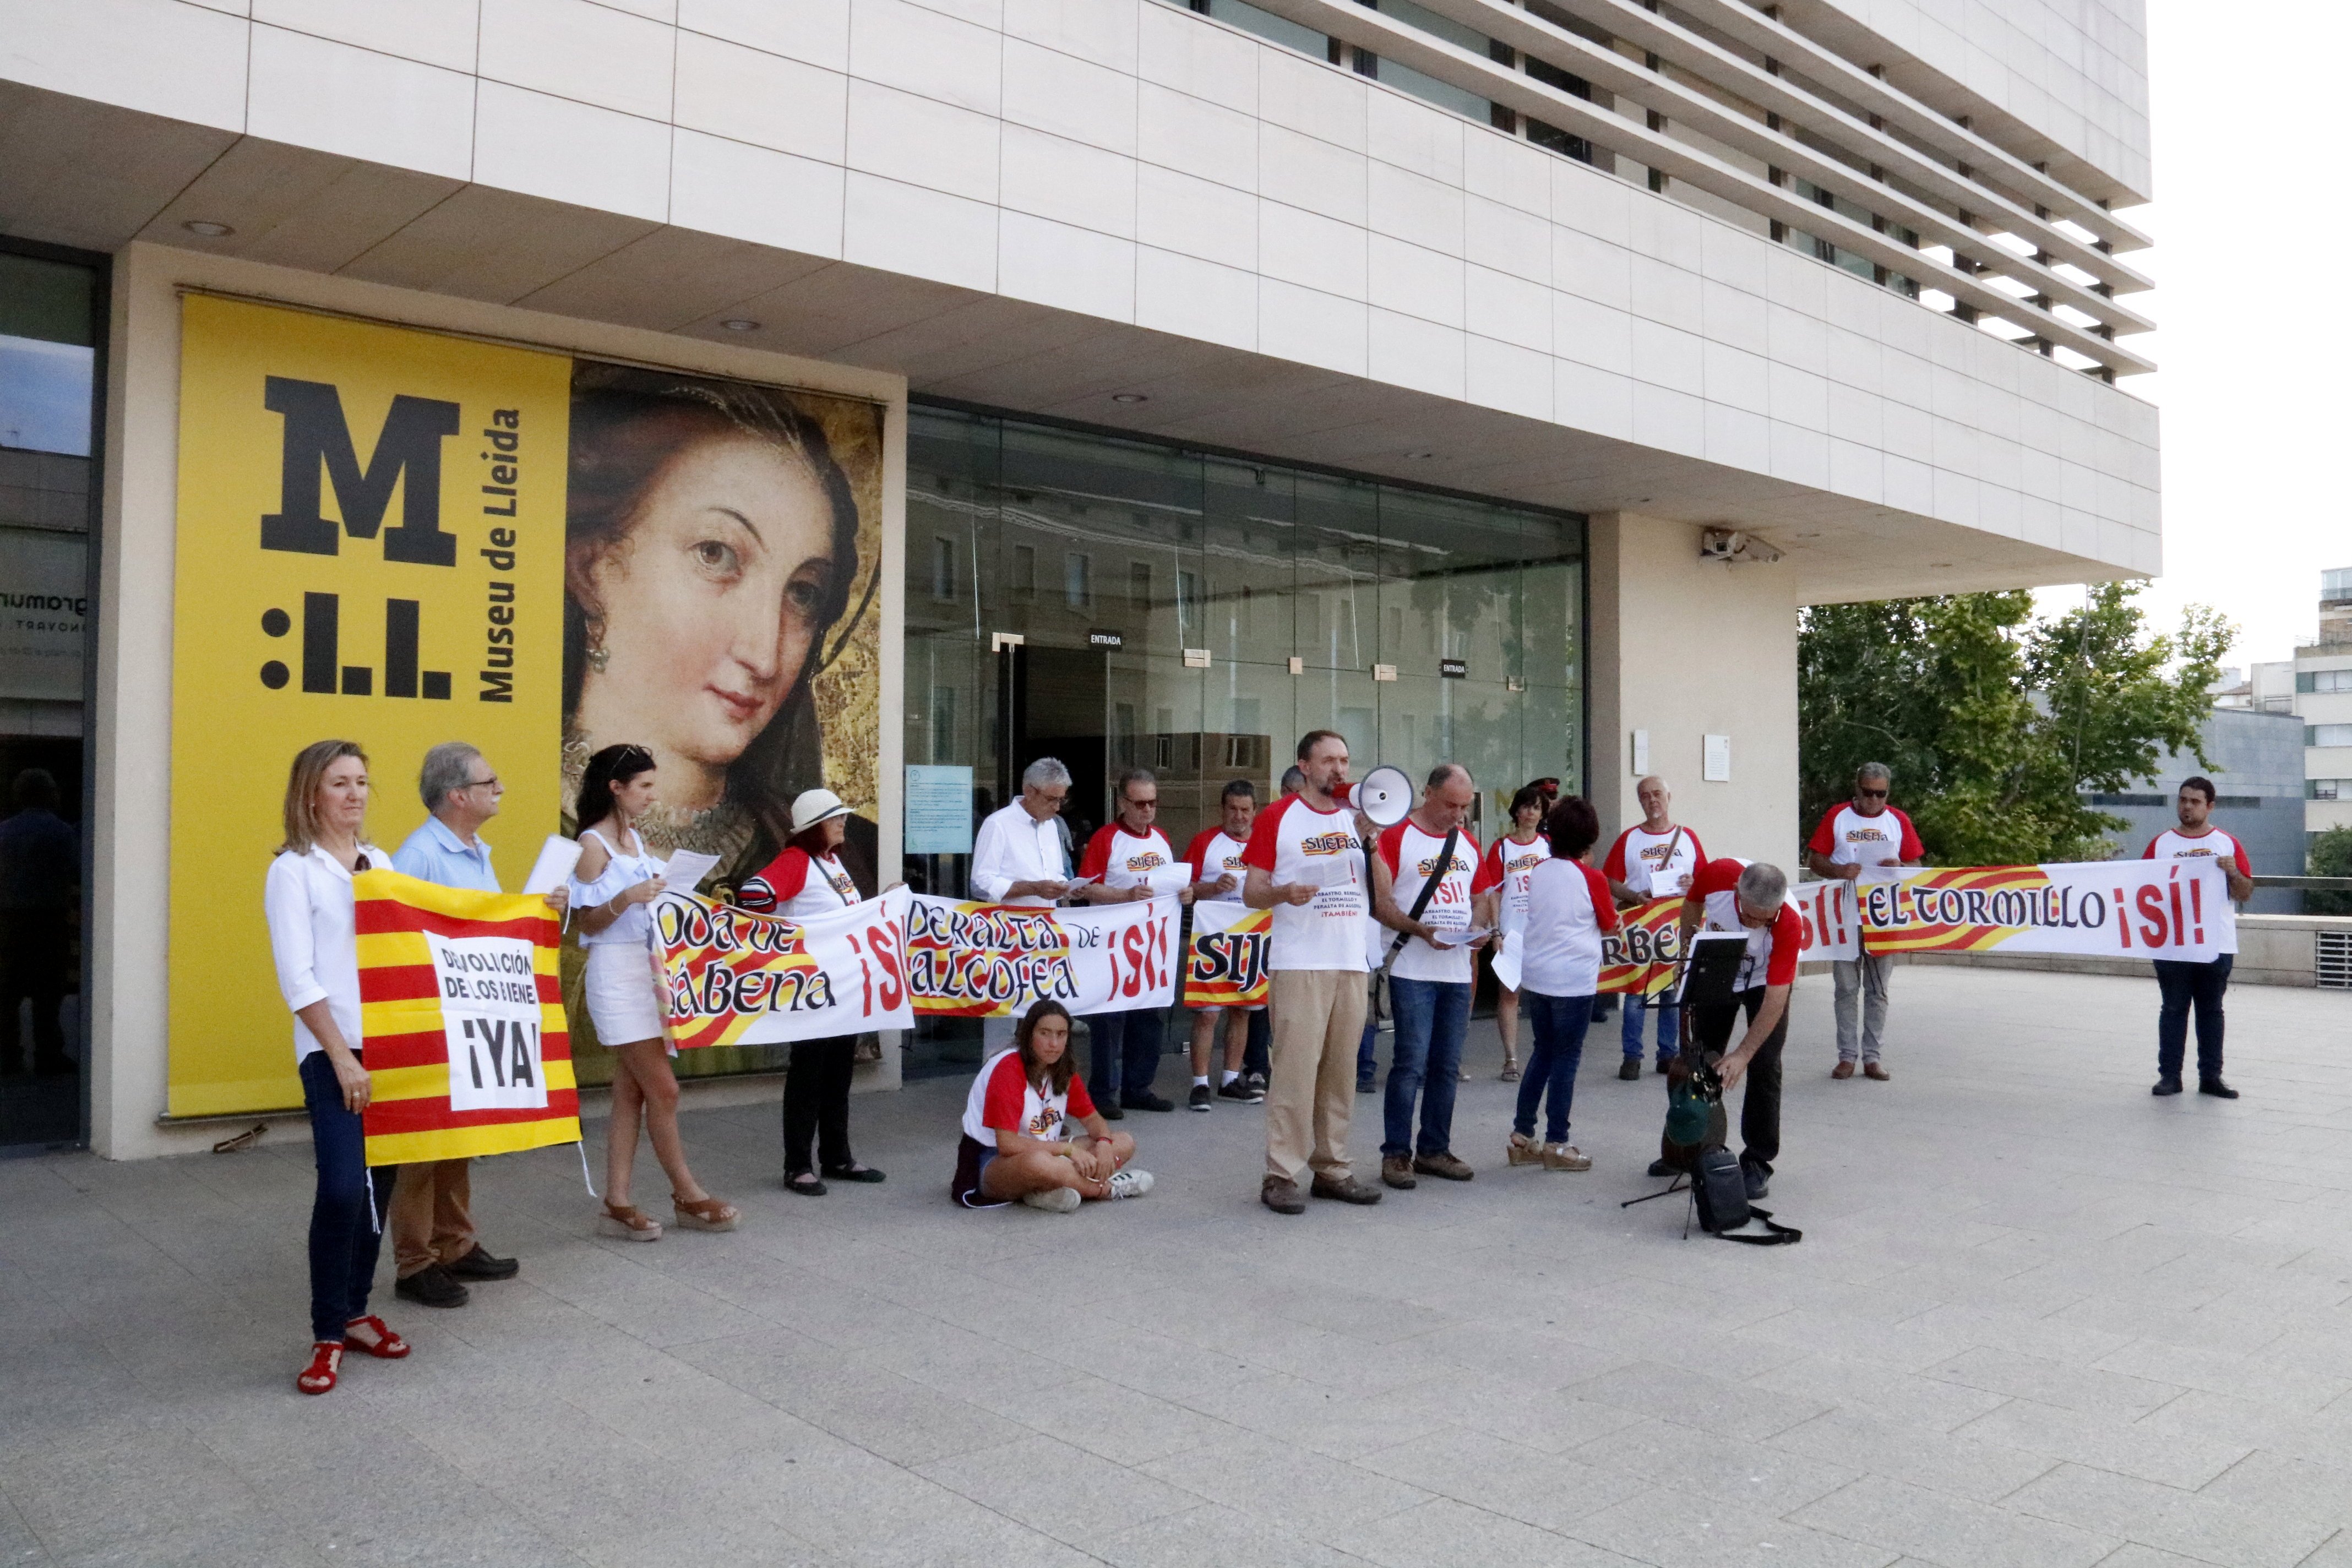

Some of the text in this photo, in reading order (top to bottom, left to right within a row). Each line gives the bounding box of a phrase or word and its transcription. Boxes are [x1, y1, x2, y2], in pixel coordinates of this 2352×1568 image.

[260, 375, 460, 567] M
[480, 409, 520, 703] Museu de Lleida
[1091, 634, 1121, 645] ENTRADA
[1444, 664, 1464, 673] ENTRADA
[1869, 865, 2204, 949] EL TORMILLO ¡SÍ!
[907, 901, 1168, 1001] PERALTA DE ¡SÍ!
[912, 948, 1079, 1010] ALCOFEA
[444, 976, 470, 998] DE
[469, 979, 499, 1001] LOS
